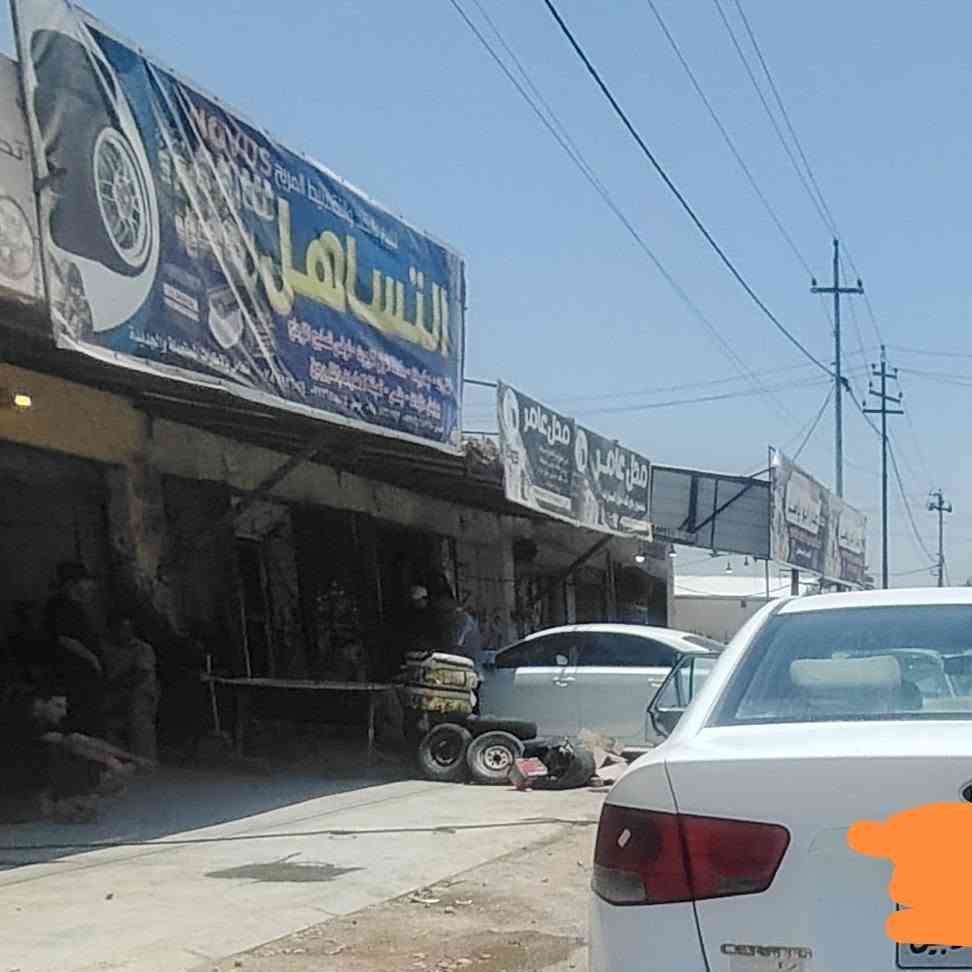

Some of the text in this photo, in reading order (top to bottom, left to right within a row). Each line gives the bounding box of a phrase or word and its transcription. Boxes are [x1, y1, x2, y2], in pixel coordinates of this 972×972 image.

[258, 197, 449, 357] التساهل
[524, 405, 571, 446] محل عامر
[589, 447, 625, 481] عامر
[625, 454, 649, 492] محل
